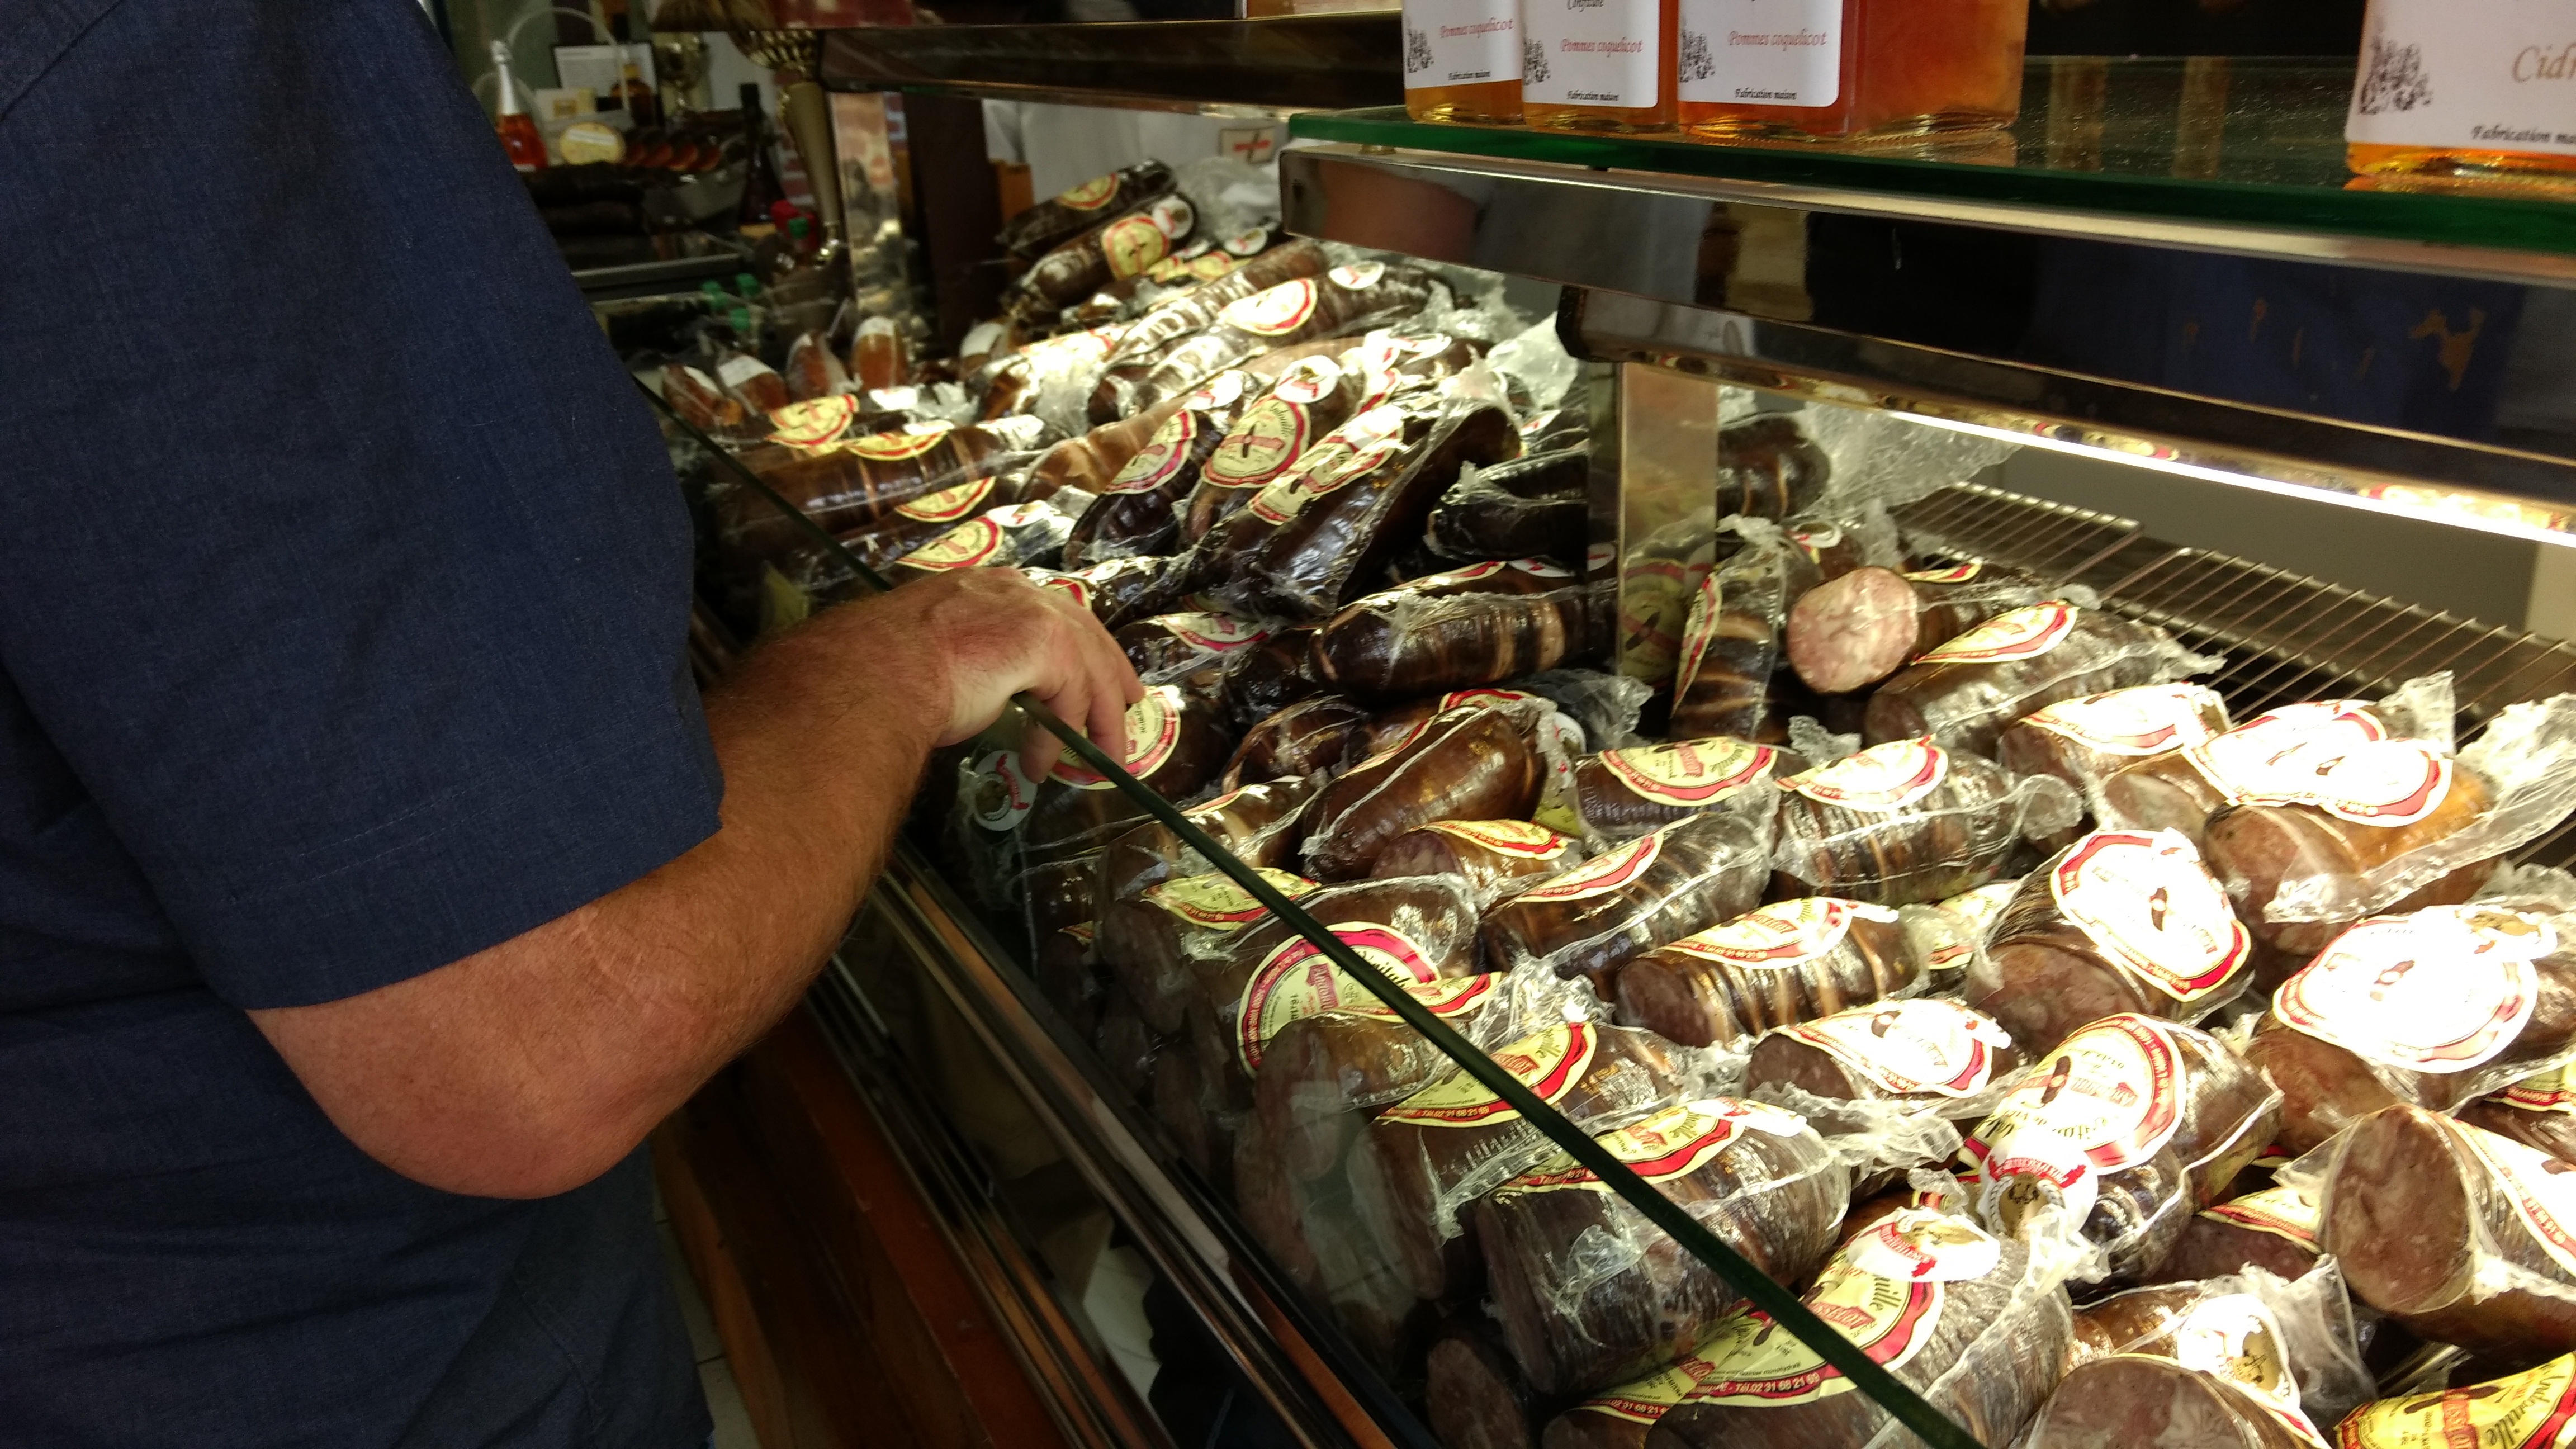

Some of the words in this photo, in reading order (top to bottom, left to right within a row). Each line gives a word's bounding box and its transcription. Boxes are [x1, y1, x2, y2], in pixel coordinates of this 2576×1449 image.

[1560, 38, 1595, 52] Pommes
[1597, 36, 1644, 57] coquelicot
[1727, 31, 1769, 46] Pommes
[1770, 28, 1827, 51] coquelicot
